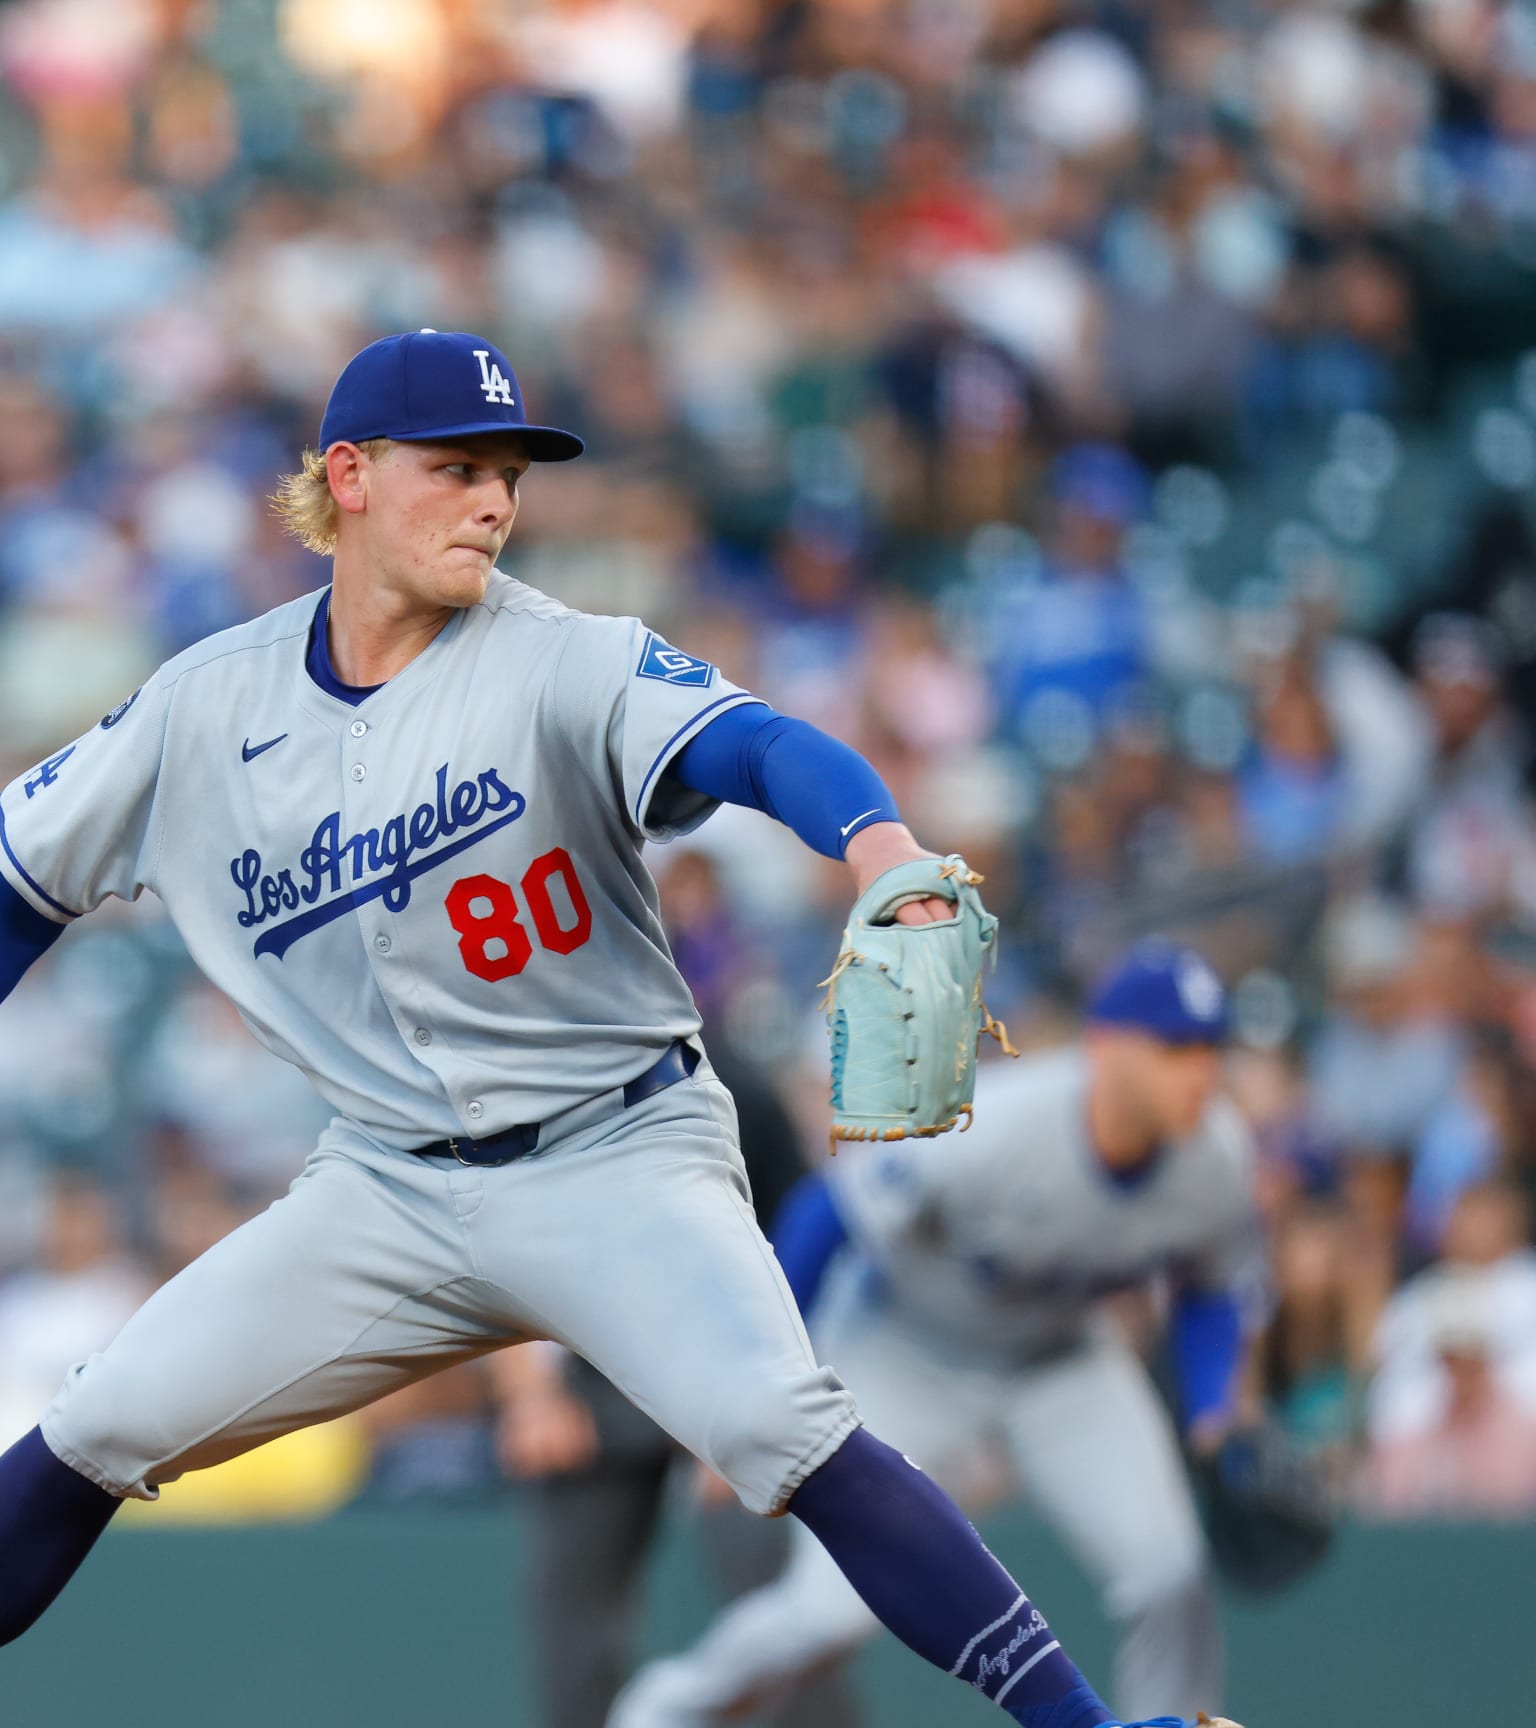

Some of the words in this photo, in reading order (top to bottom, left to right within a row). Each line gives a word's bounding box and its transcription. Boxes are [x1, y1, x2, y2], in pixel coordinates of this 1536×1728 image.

[472, 350, 515, 406] LA
[230, 848, 295, 928] Los
[300, 762, 514, 913] Angeles
[444, 846, 592, 983] 80
